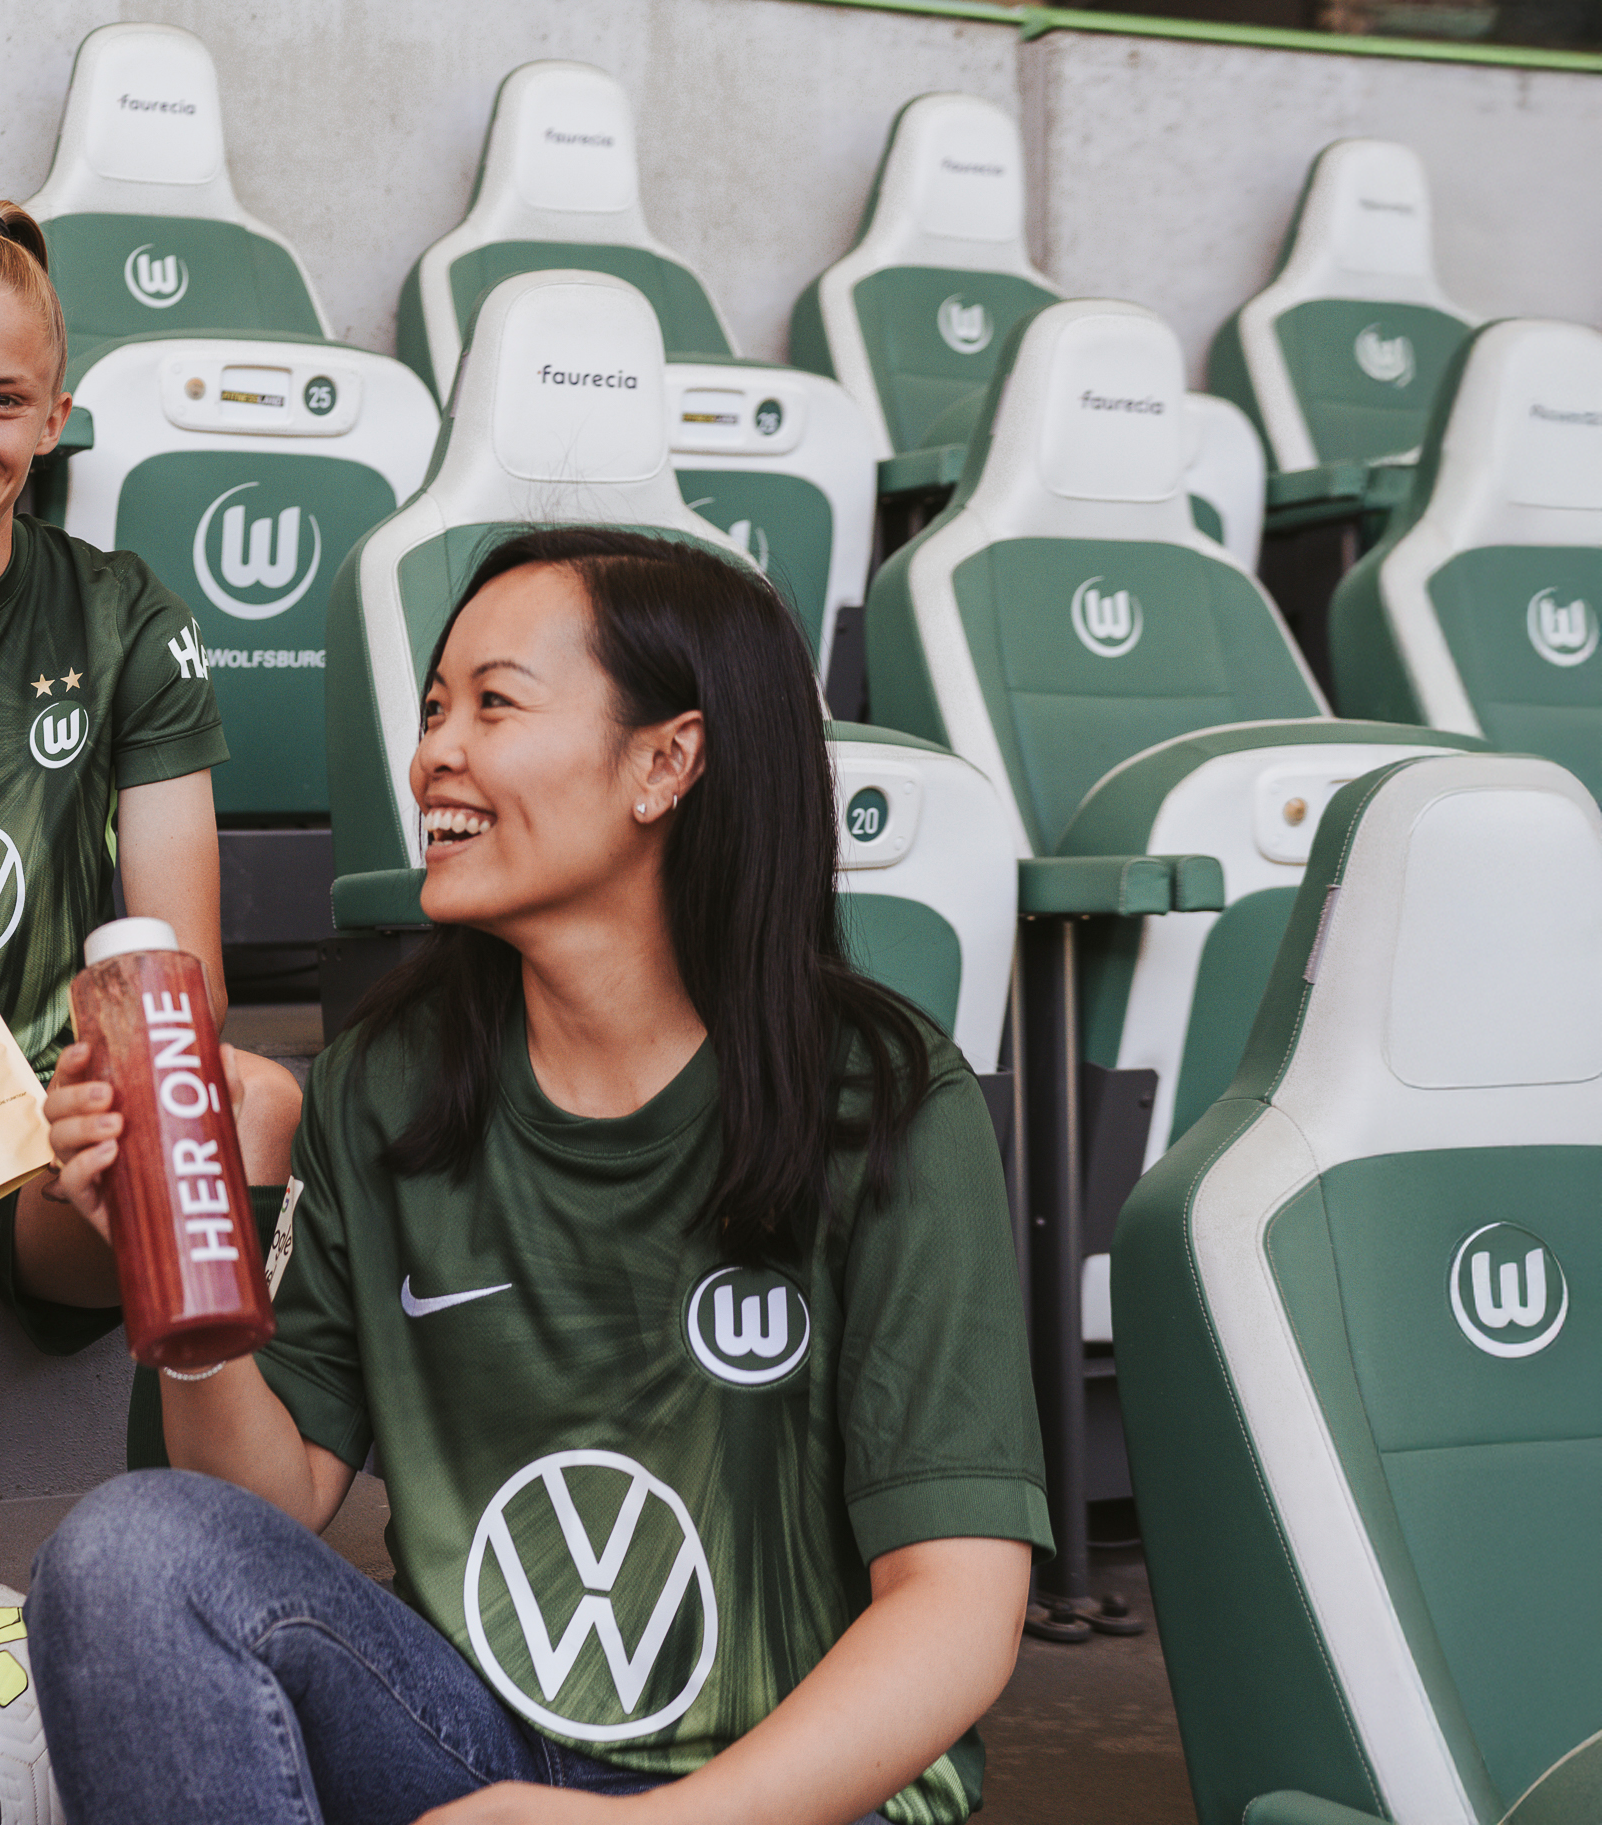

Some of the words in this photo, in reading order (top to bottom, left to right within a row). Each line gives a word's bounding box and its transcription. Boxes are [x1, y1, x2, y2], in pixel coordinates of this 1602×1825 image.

[119, 93, 196, 116] faurecia
[542, 364, 637, 390] faurecia
[308, 386, 332, 409] 25
[1081, 389, 1165, 415] faurecia
[206, 648, 327, 669] WOLFSBURG
[851, 807, 879, 835] 20
[142, 991, 221, 1119] ONE
[172, 1138, 240, 1262] HER
